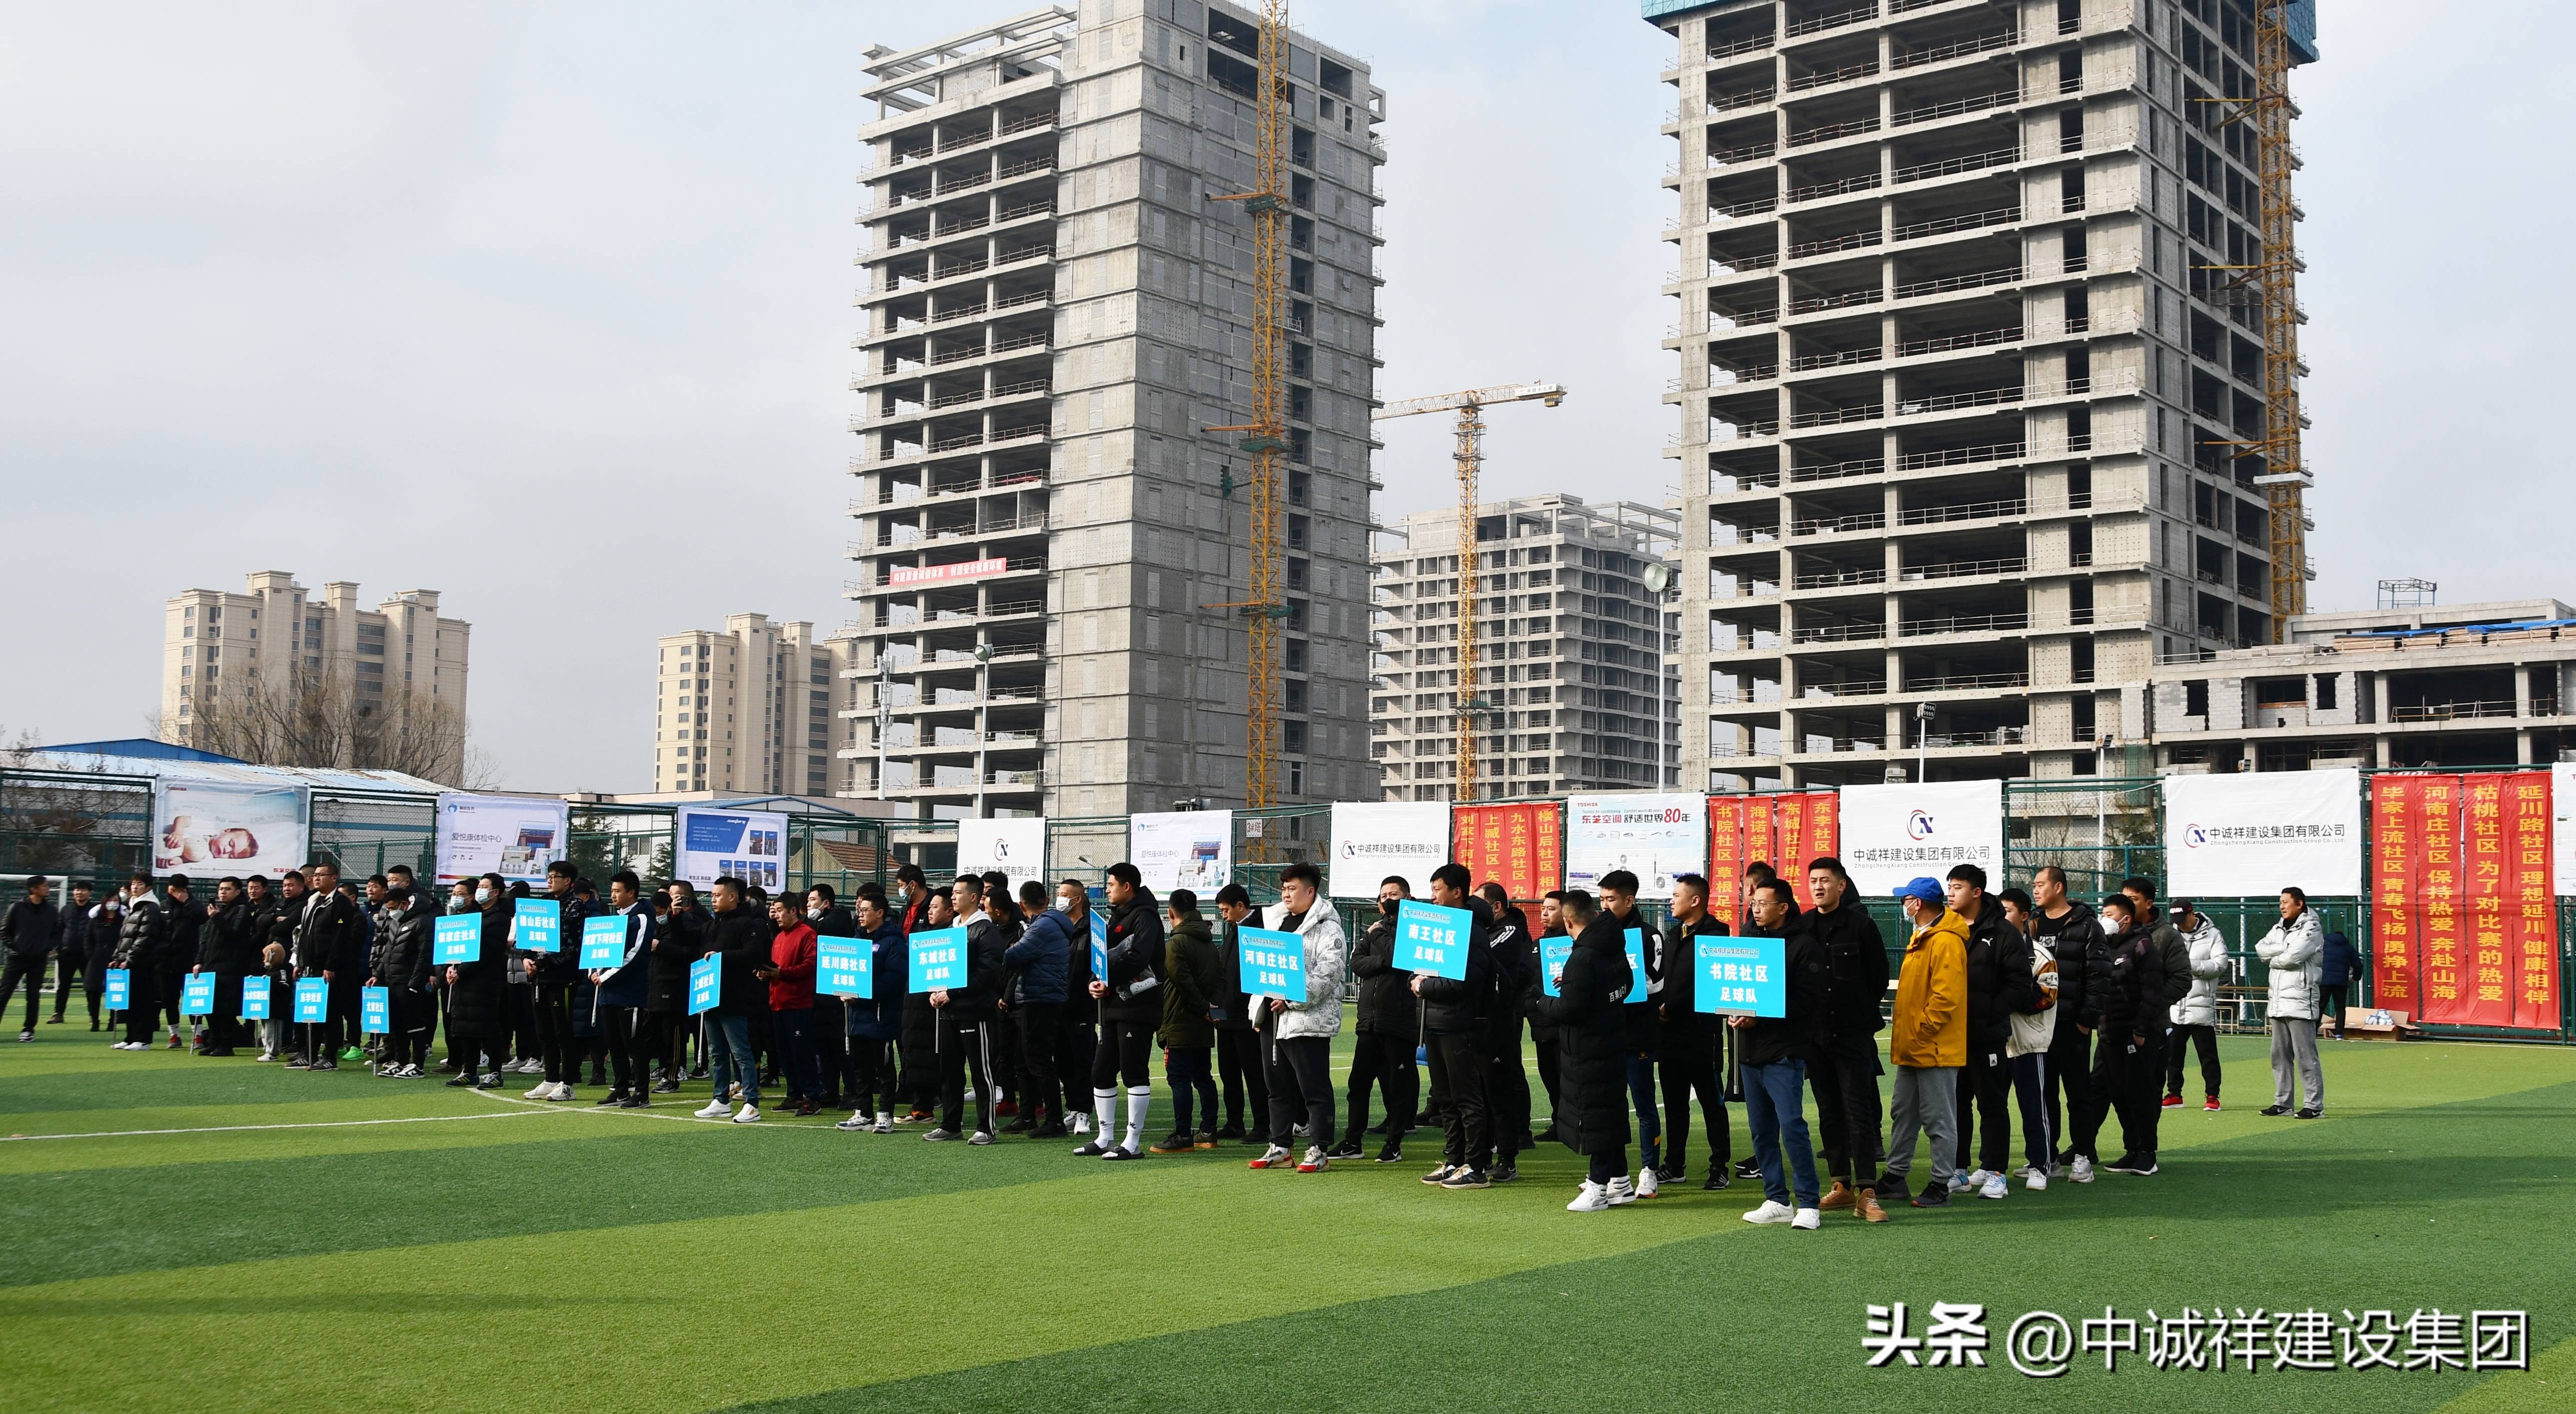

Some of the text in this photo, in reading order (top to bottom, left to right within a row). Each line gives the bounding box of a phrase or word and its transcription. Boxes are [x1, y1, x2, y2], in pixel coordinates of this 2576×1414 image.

[894, 560, 1002, 582] 构建质量诚信体系 创造安全健康环境
[1582, 808, 1691, 824] 东芝空调 舒适世界80年
[1716, 806, 1734, 861] 书院社区
[1750, 806, 1767, 862] 海诺学校
[1784, 803, 1801, 859] 东城社区
[1813, 803, 1831, 851] 东李社区
[2210, 824, 2345, 839] 中诚祥建设集团有限公司
[2380, 786, 2406, 873] 毕家上流社区
[452, 833, 502, 843] 爱悦康体检中心
[1511, 813, 1527, 880] 九水东路社区
[1538, 811, 1554, 871] 楼山后社区
[1358, 843, 1440, 854] 中诚祥建设集团有限公司
[1854, 846, 1990, 862] 中诚祥建设集团有限公司
[2425, 786, 2457, 1000] 河南庄社区 保持热爱 奔赴山海
[2473, 785, 2503, 1002] 枯桃社区 为了对比赛的热爱
[2517, 785, 2550, 1004] 延川路社区 理想延川 健康相伴
[2381, 878, 2406, 935] 青春飞扬
[529, 931, 547, 942] 足球队
[1408, 923, 1456, 946] 南王社区
[591, 948, 609, 959] 足球队
[919, 948, 957, 965] 东城社区
[1245, 949, 1299, 971] 河南庄社区
[1414, 946, 1445, 964] 足球队
[821, 956, 867, 973] 延川路社区
[925, 968, 950, 980] 足球队
[1710, 962, 1769, 982] 书院社区
[833, 974, 856, 987] 足球队
[1259, 972, 1286, 987] 足球队
[1720, 987, 1758, 1004] 足球队
